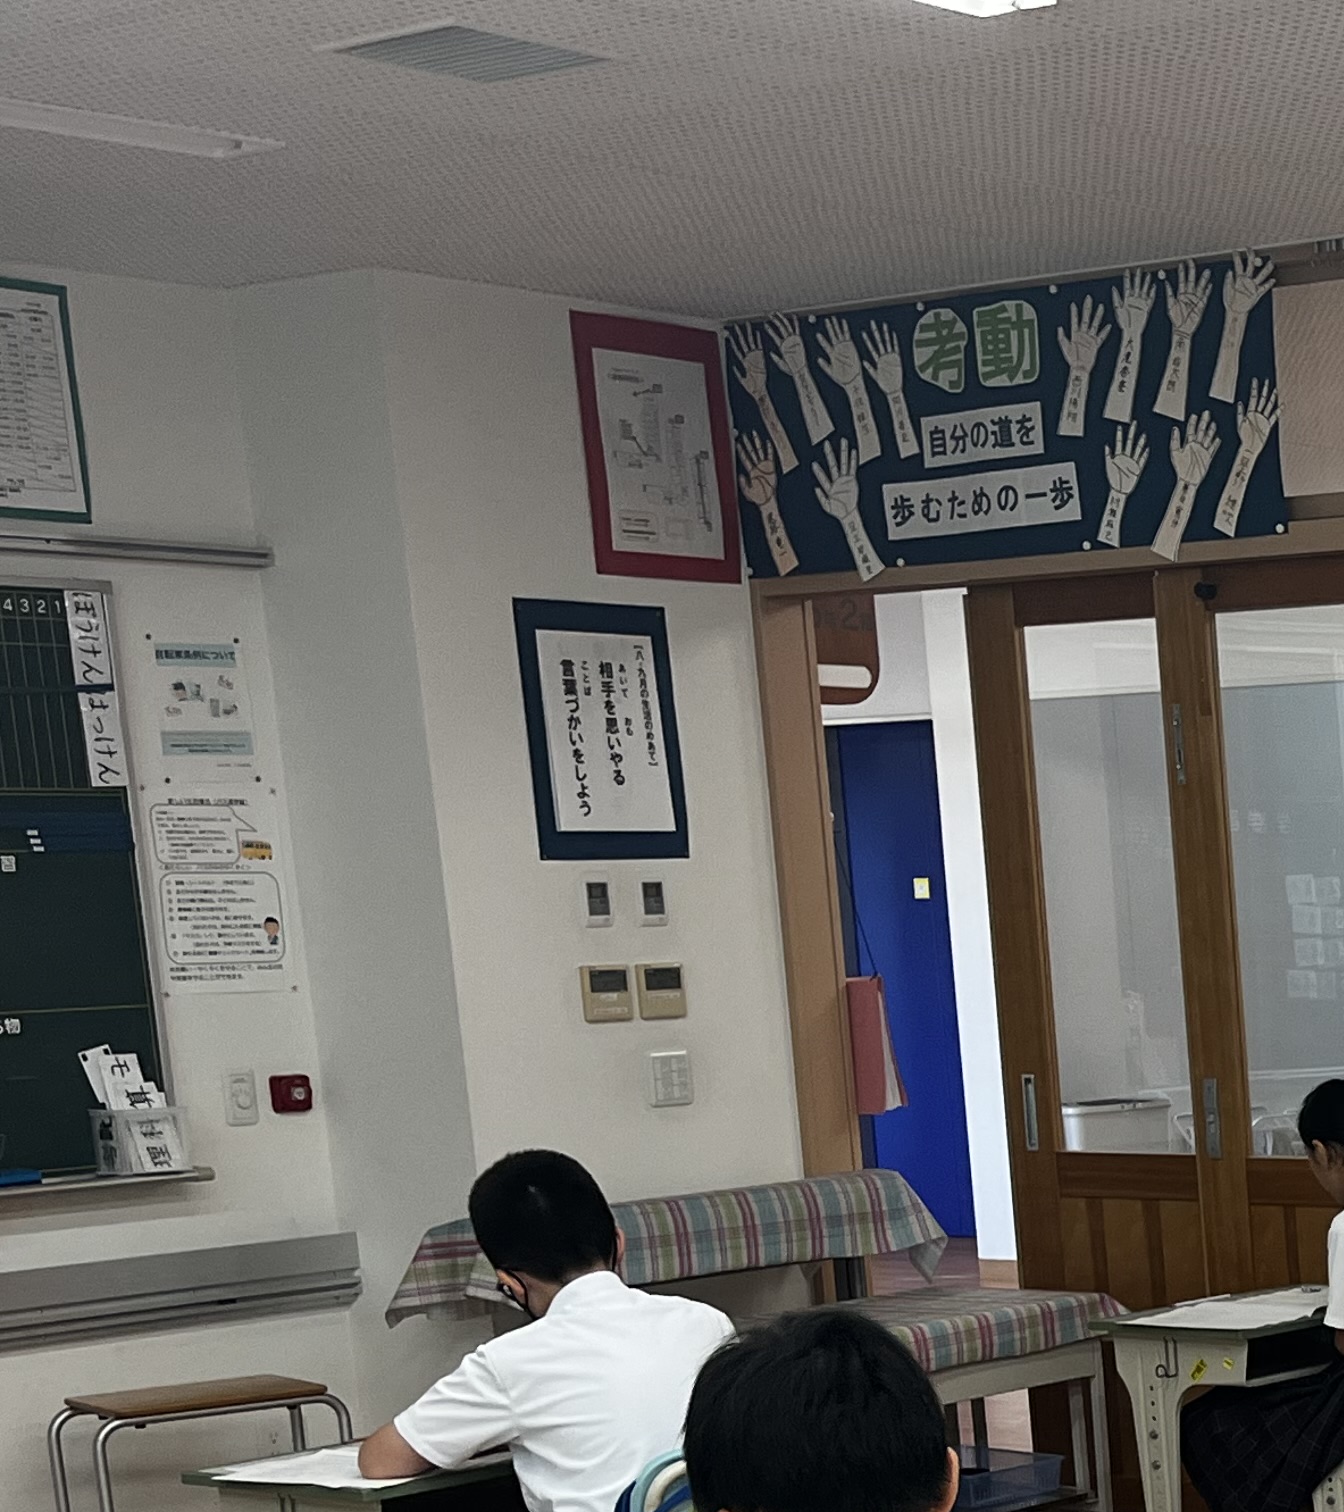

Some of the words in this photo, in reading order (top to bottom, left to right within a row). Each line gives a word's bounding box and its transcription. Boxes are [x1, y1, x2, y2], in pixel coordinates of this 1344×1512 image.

[914, 301, 1037, 392] 考動
[928, 414, 1036, 458] 自分の道を
[890, 476, 1075, 527] 歩むための一歩
[2, 598, 13, 612] 4
[19, 598, 30, 613] 3
[36, 599, 47, 614] 2
[54, 600, 62, 614] 1
[71, 591, 104, 685] ぼうけん
[598, 661, 626, 786] 相手を思いやる
